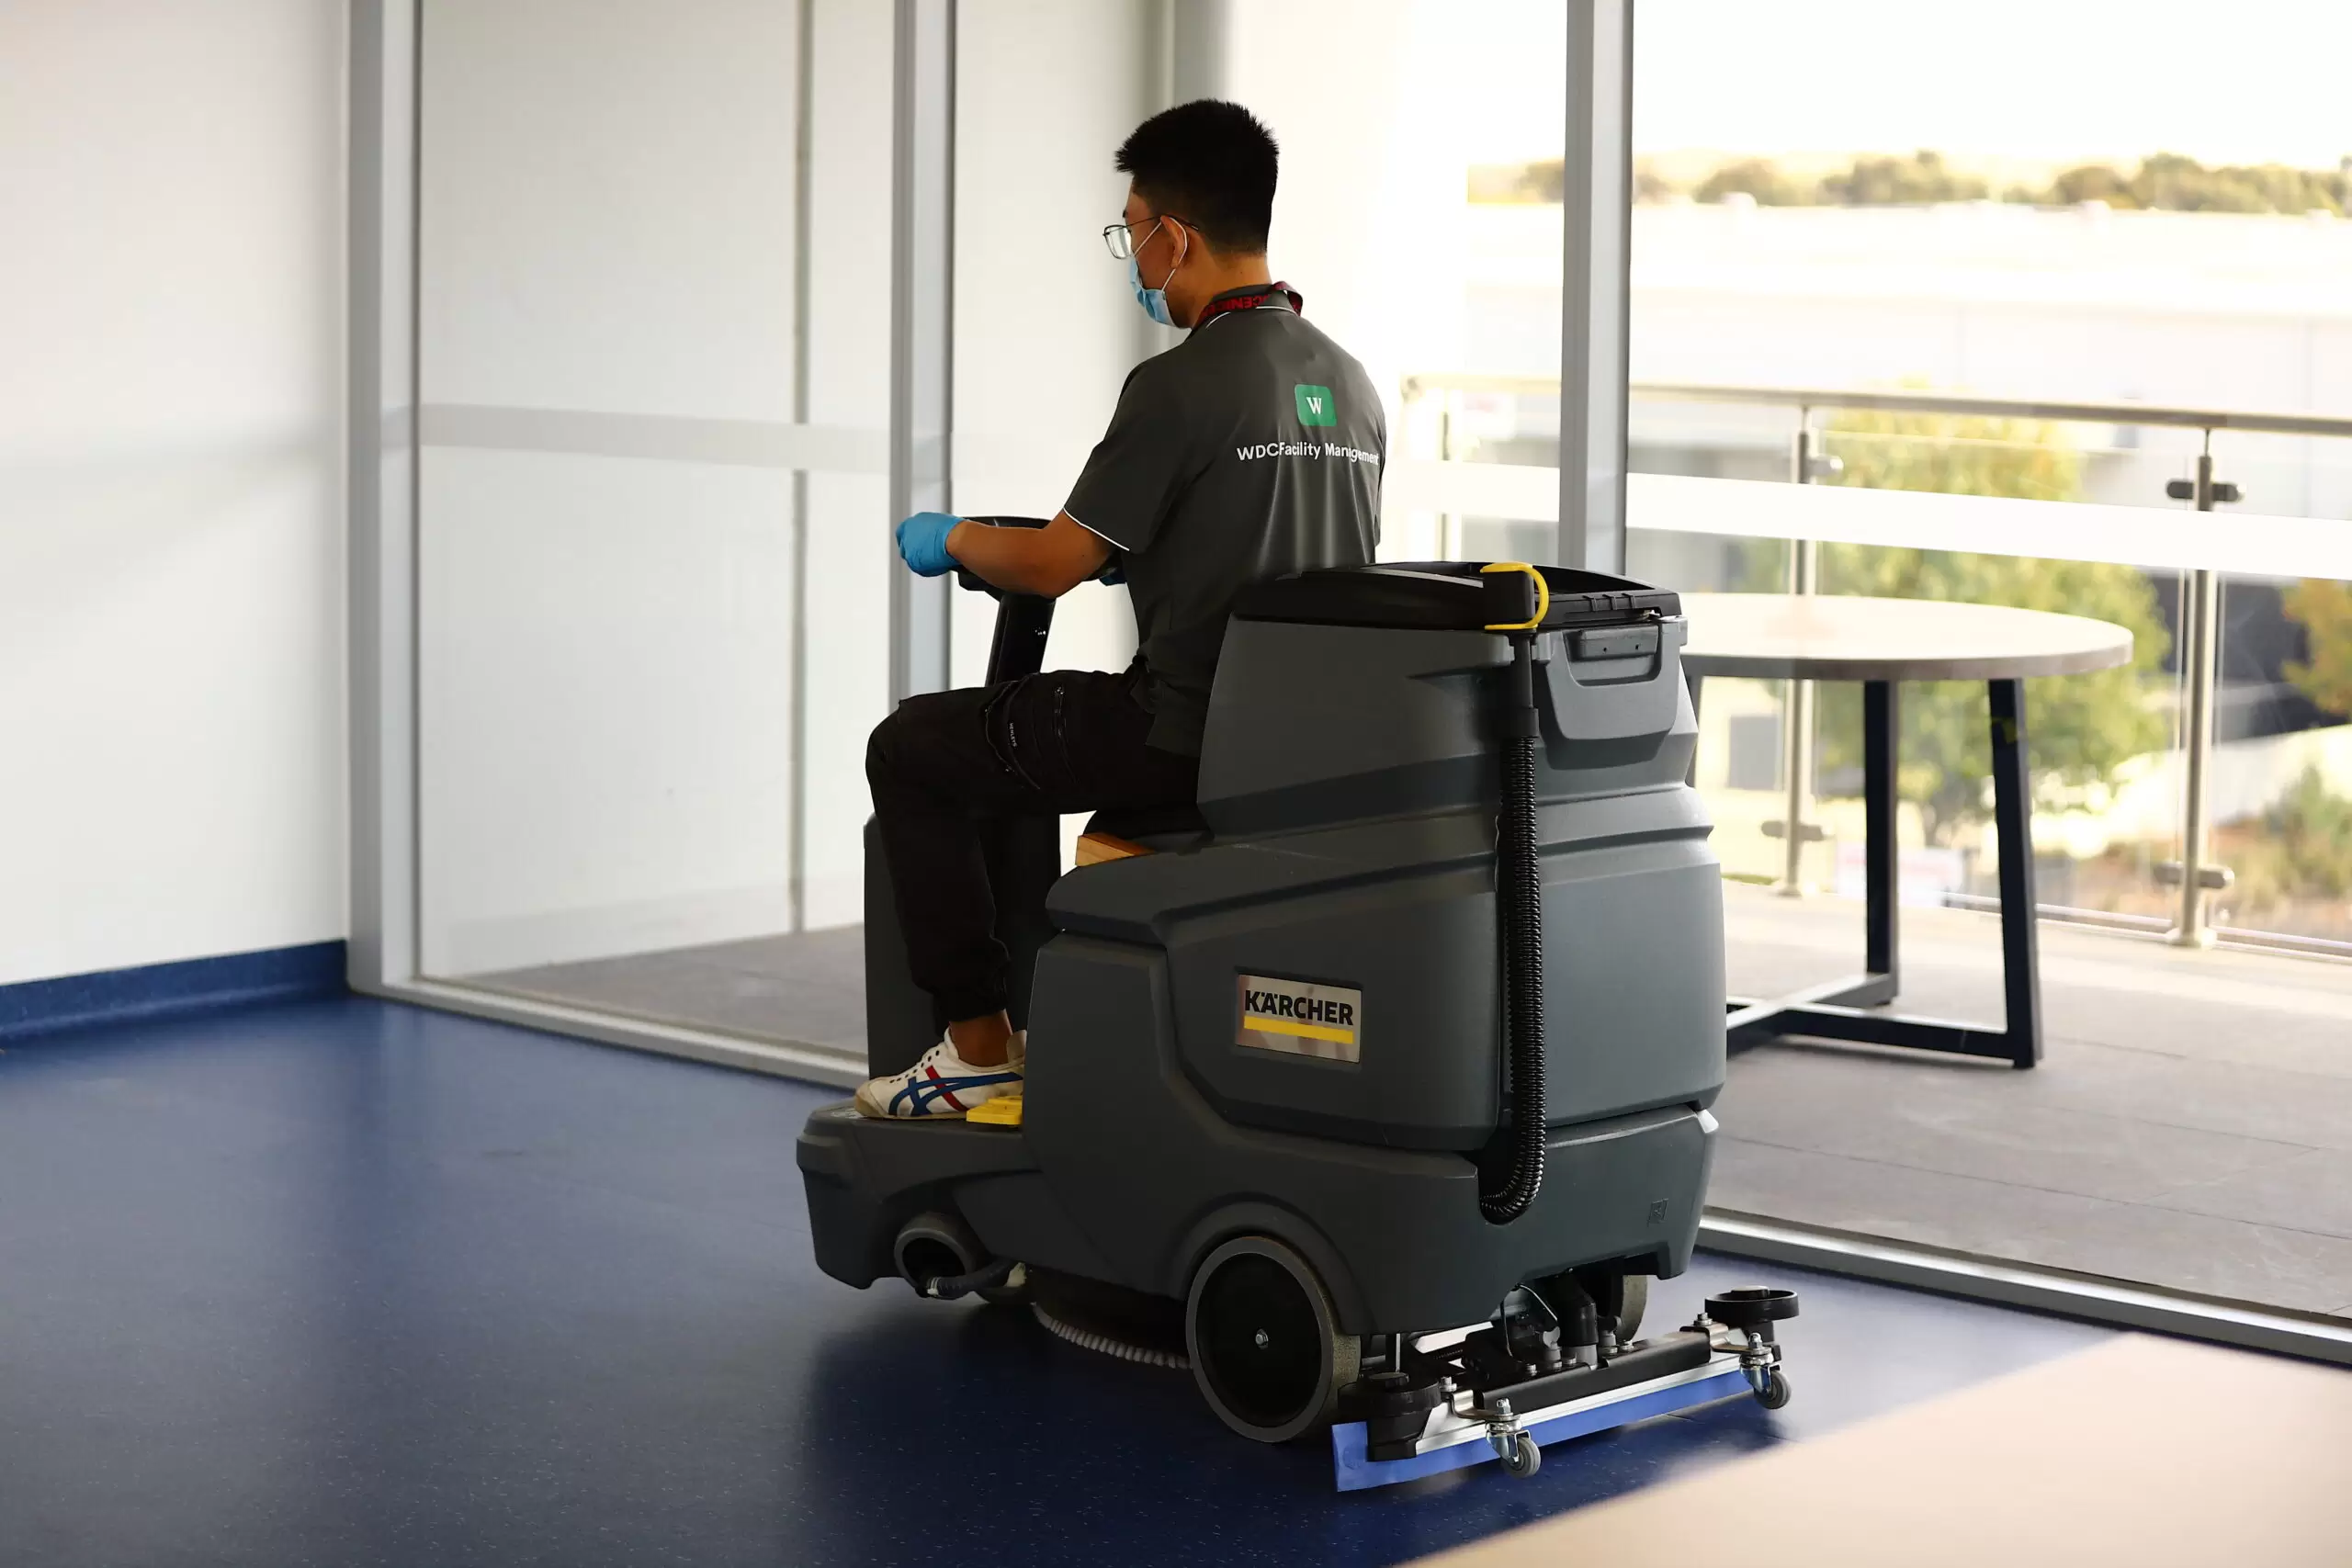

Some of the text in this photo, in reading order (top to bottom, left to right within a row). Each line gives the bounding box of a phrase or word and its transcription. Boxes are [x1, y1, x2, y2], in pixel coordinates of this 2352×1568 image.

[1306, 397, 1322, 414] W
[1324, 442, 1379, 466] Mangement
[1245, 990, 1353, 1025] KÄRCHER
